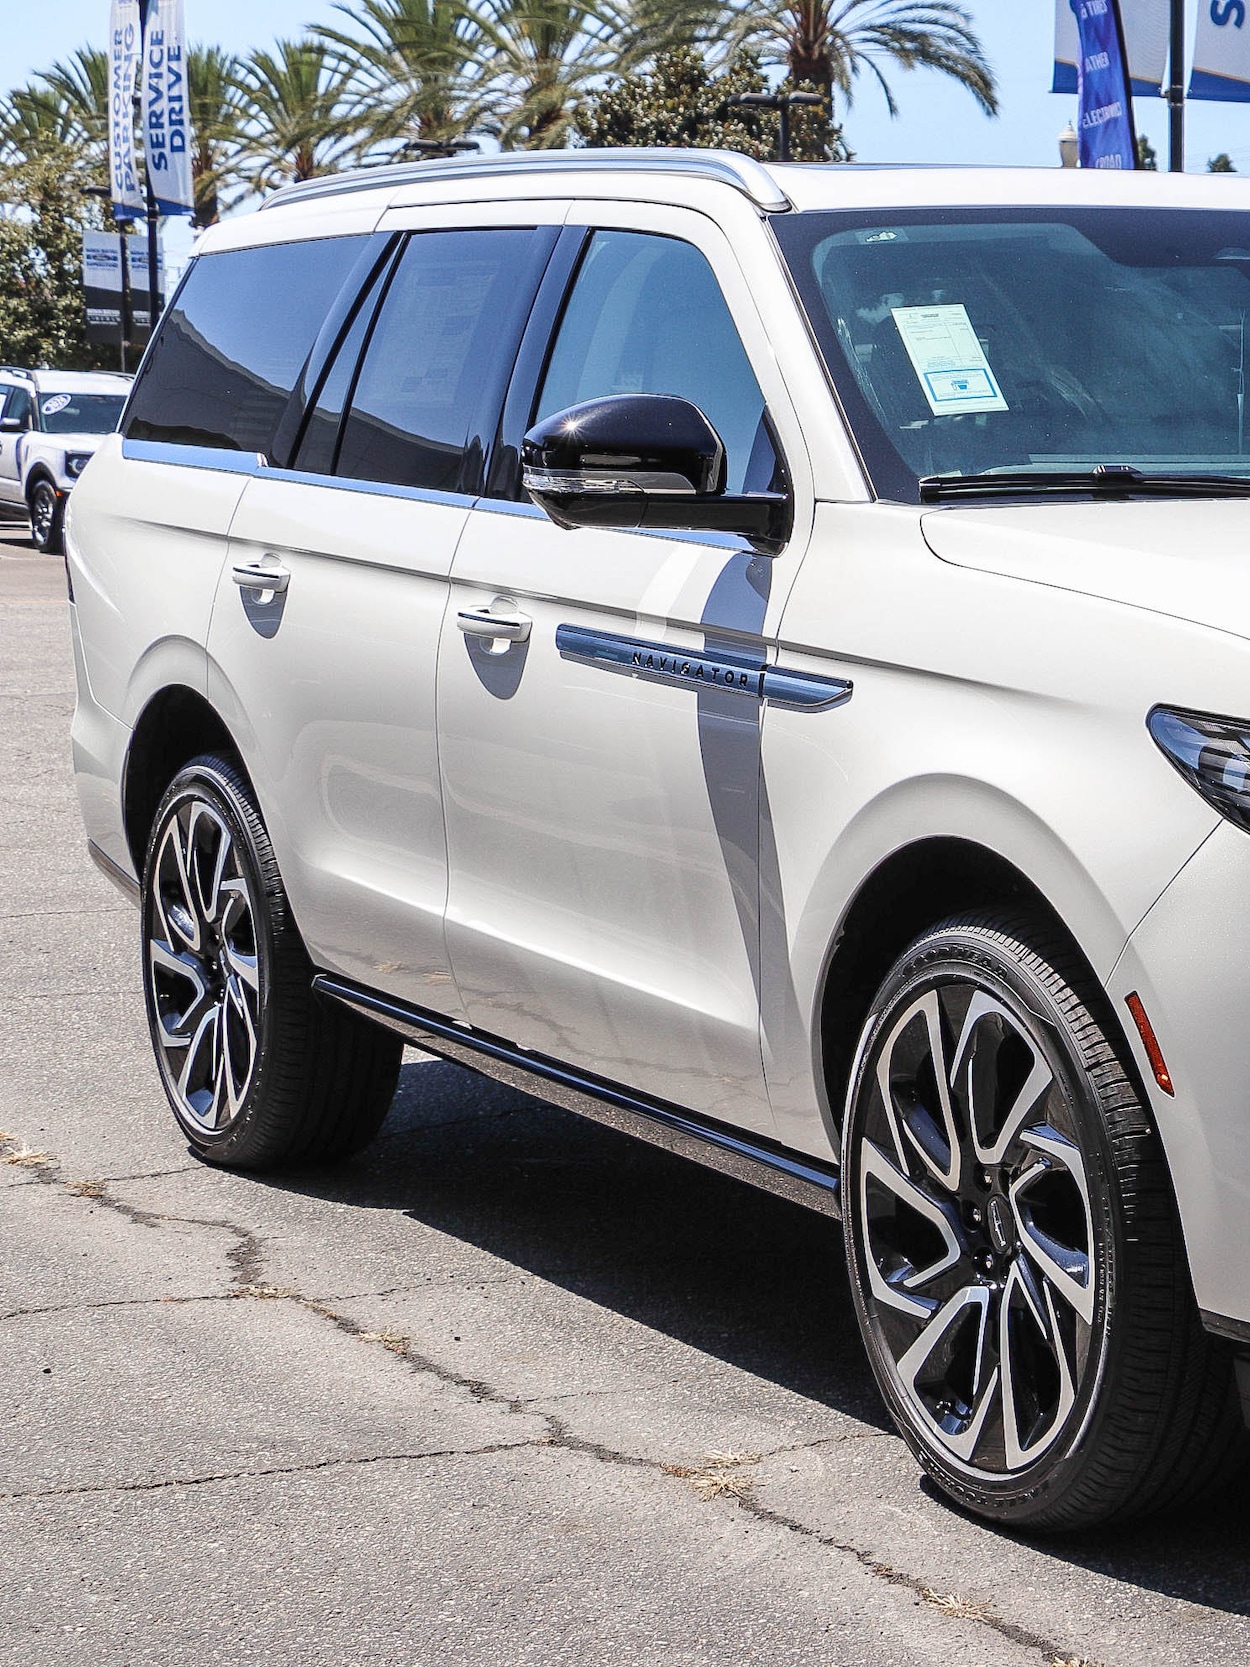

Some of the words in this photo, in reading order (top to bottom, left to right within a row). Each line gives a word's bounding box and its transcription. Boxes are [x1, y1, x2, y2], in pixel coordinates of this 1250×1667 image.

[113, 29, 123, 190] CUSTOMER
[122, 23, 135, 192] PARKING
[149, 30, 168, 171] SERVICE
[168, 45, 185, 152] DRIVE
[632, 651, 748, 687] NAVIGATOR
